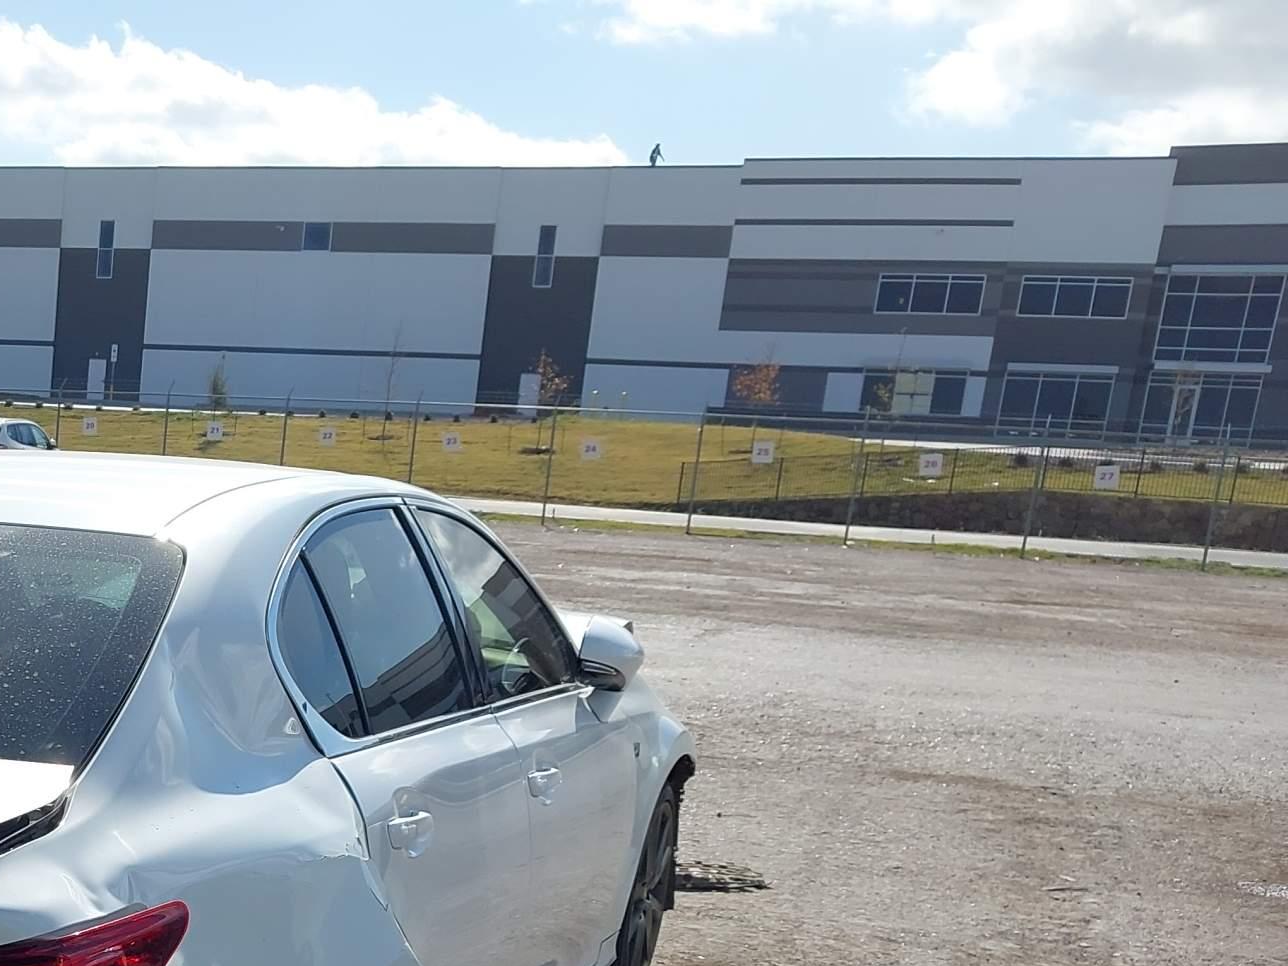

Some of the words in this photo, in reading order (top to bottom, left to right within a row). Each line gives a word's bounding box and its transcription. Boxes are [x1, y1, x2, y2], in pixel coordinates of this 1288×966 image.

[210, 426, 220, 434] 21
[322, 432, 333, 440] 22
[445, 437, 457, 445] 23
[756, 448, 769, 456] 25
[1100, 472, 1114, 481] 27
